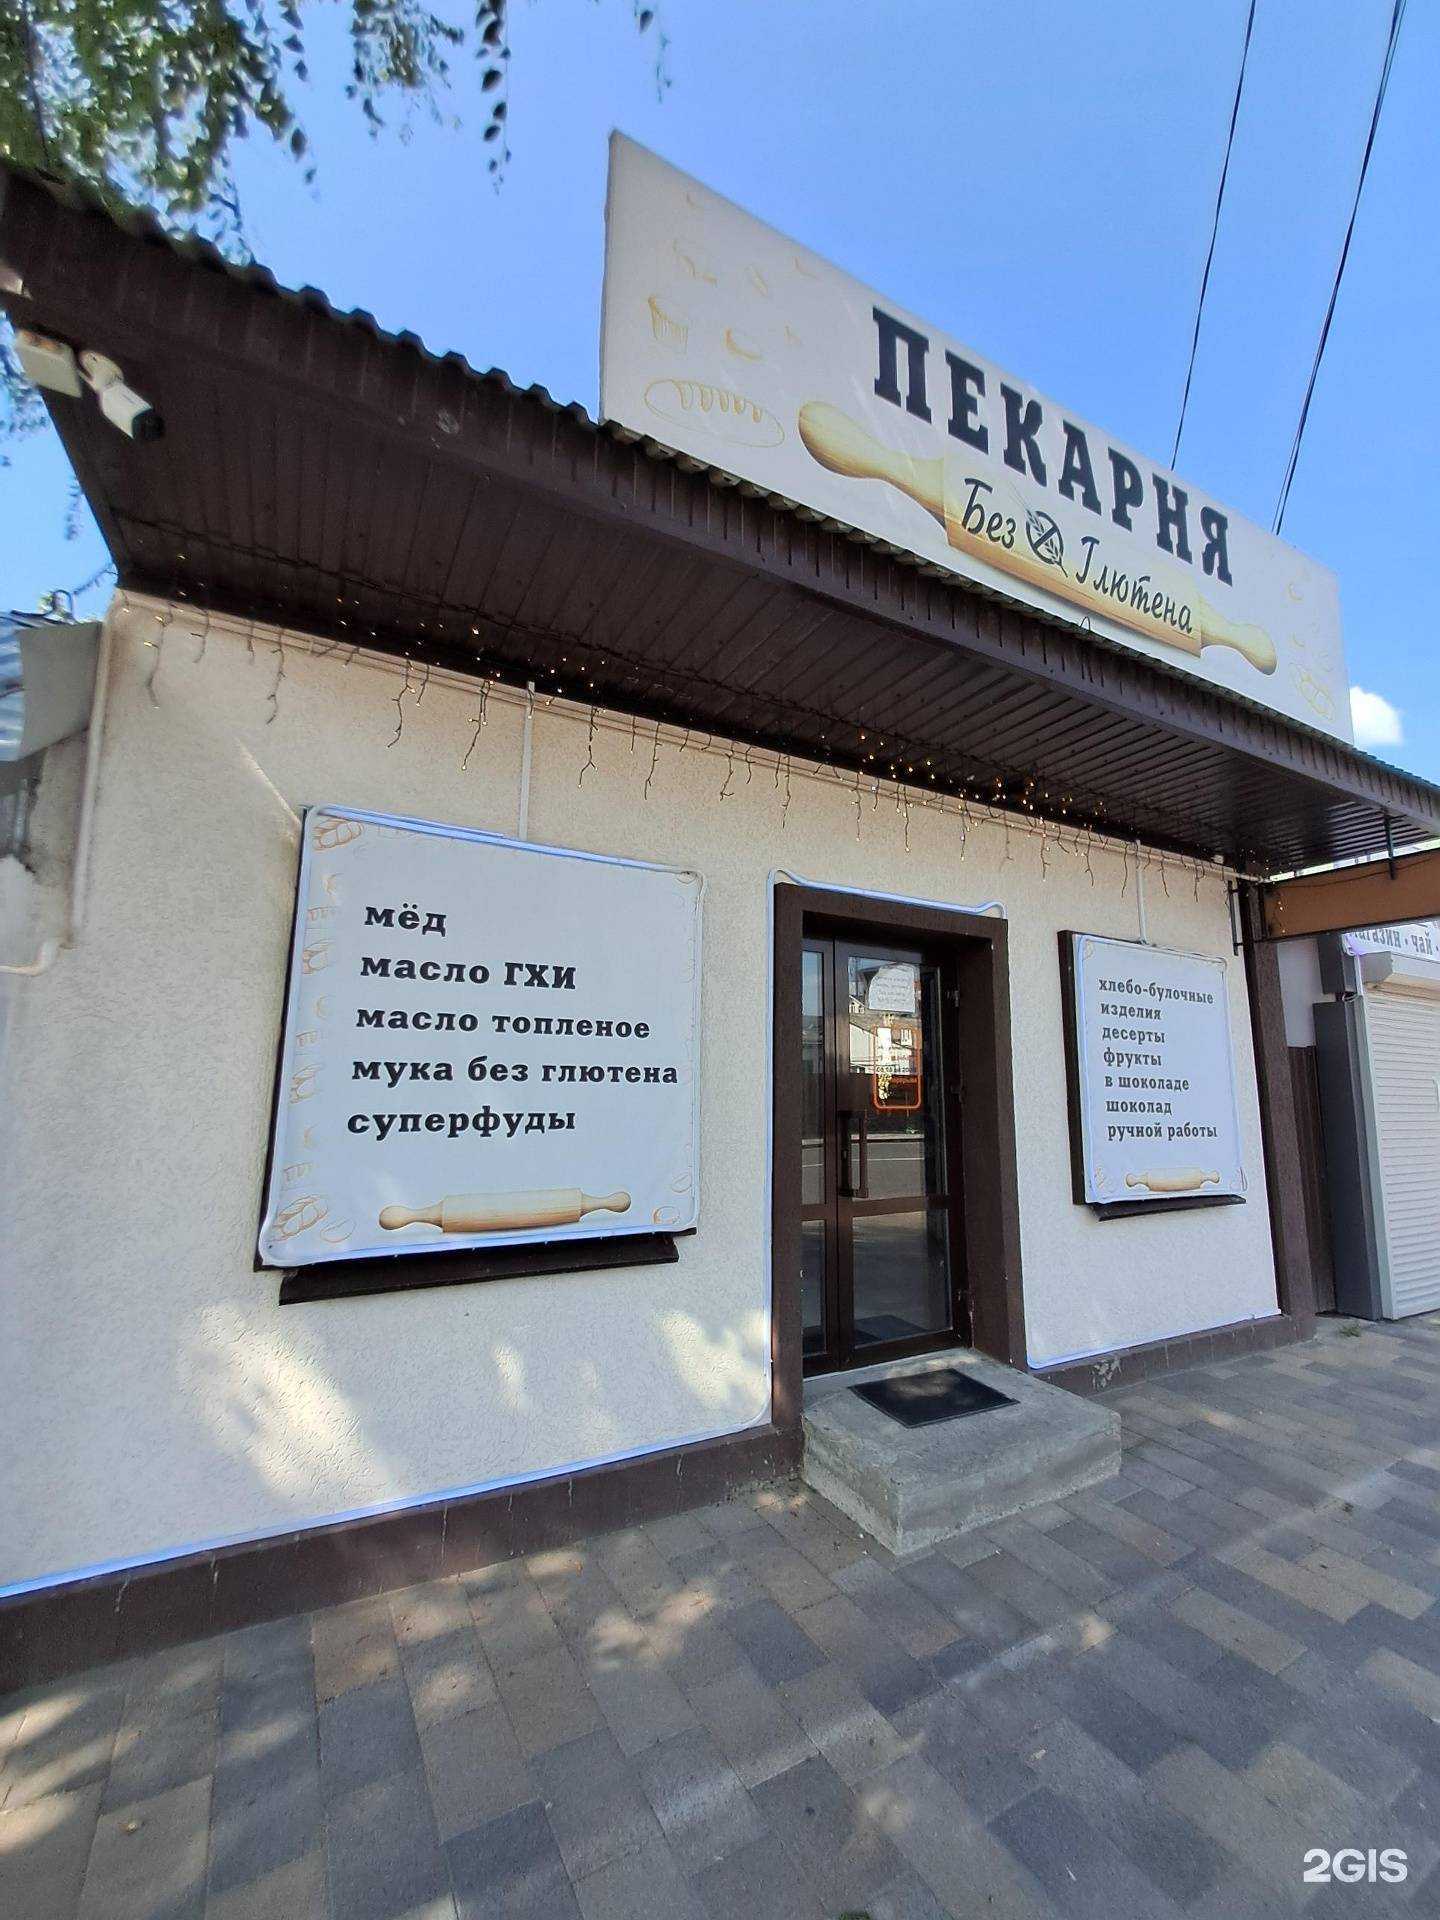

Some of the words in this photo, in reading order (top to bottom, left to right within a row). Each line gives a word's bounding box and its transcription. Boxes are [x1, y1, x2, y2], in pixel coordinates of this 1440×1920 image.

[873, 306, 1232, 586] ПЕКАРНЯ
[961, 478, 1016, 549] Без
[1075, 536, 1193, 634] Глютена
[364, 903, 447, 937] мёд
[360, 957, 490, 984] масло
[1099, 978, 1214, 1004] хлебо-булочные
[356, 1009, 479, 1032] масло
[492, 1015, 650, 1039] топленое
[1101, 1003, 1161, 1020] изделия
[1102, 1027, 1165, 1044] десерты
[1103, 1047, 1162, 1069] фрукты
[352, 1061, 453, 1088] мука
[467, 1056, 529, 1082] без
[541, 1064, 678, 1084] глютена
[1105, 1076, 1113, 1087] в
[1119, 1075, 1190, 1091] шоколаде
[1106, 1100, 1172, 1116] шоколад
[347, 1106, 576, 1141] суперфуды
[1108, 1122, 1163, 1142] ручной
[1168, 1122, 1217, 1140] работы
